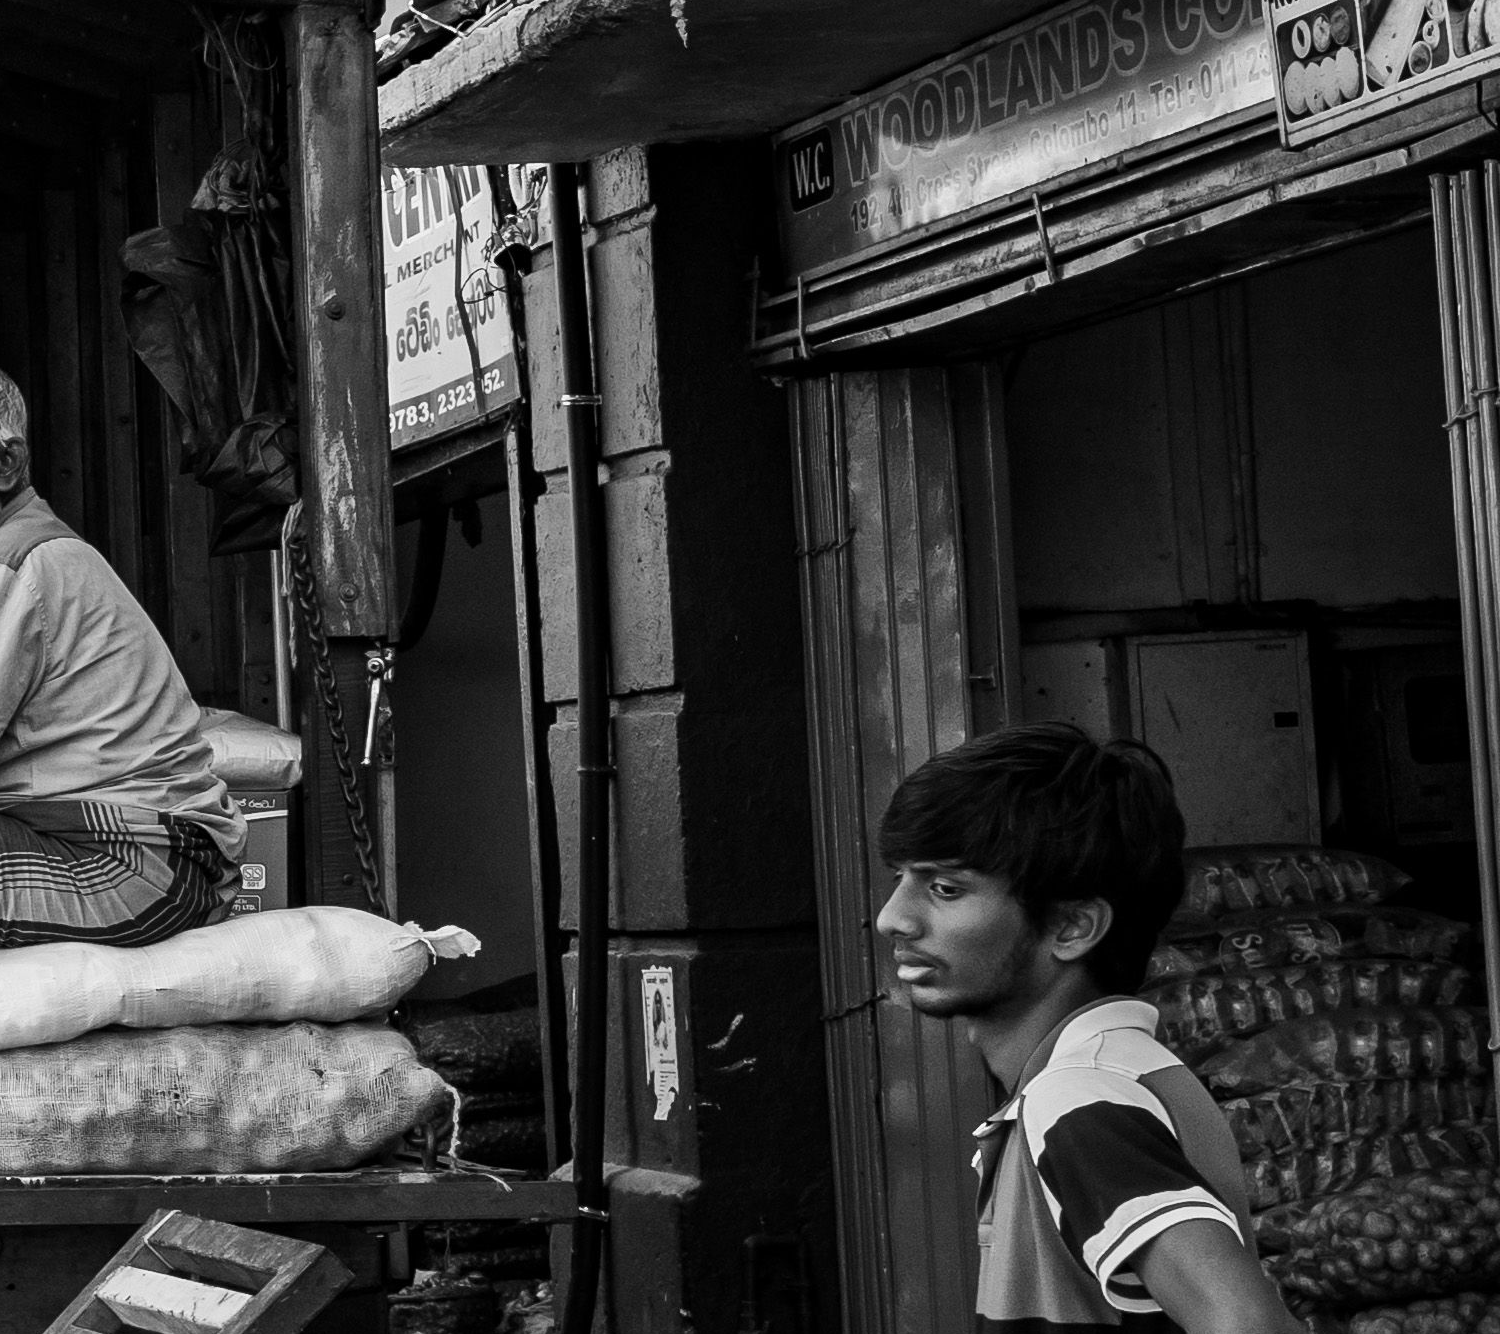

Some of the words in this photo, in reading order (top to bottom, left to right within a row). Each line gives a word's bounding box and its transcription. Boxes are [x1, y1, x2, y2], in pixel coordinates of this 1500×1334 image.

[886, 183, 911, 218] 4th
[915, 171, 962, 209] Cross
[1029, 109, 1109, 159] Colombo
[1198, 61, 1237, 100] 011
[793, 144, 830, 199] W.C.
[396, 220, 480, 283] MERCHNT
[438, 369, 505, 415] 232352.
